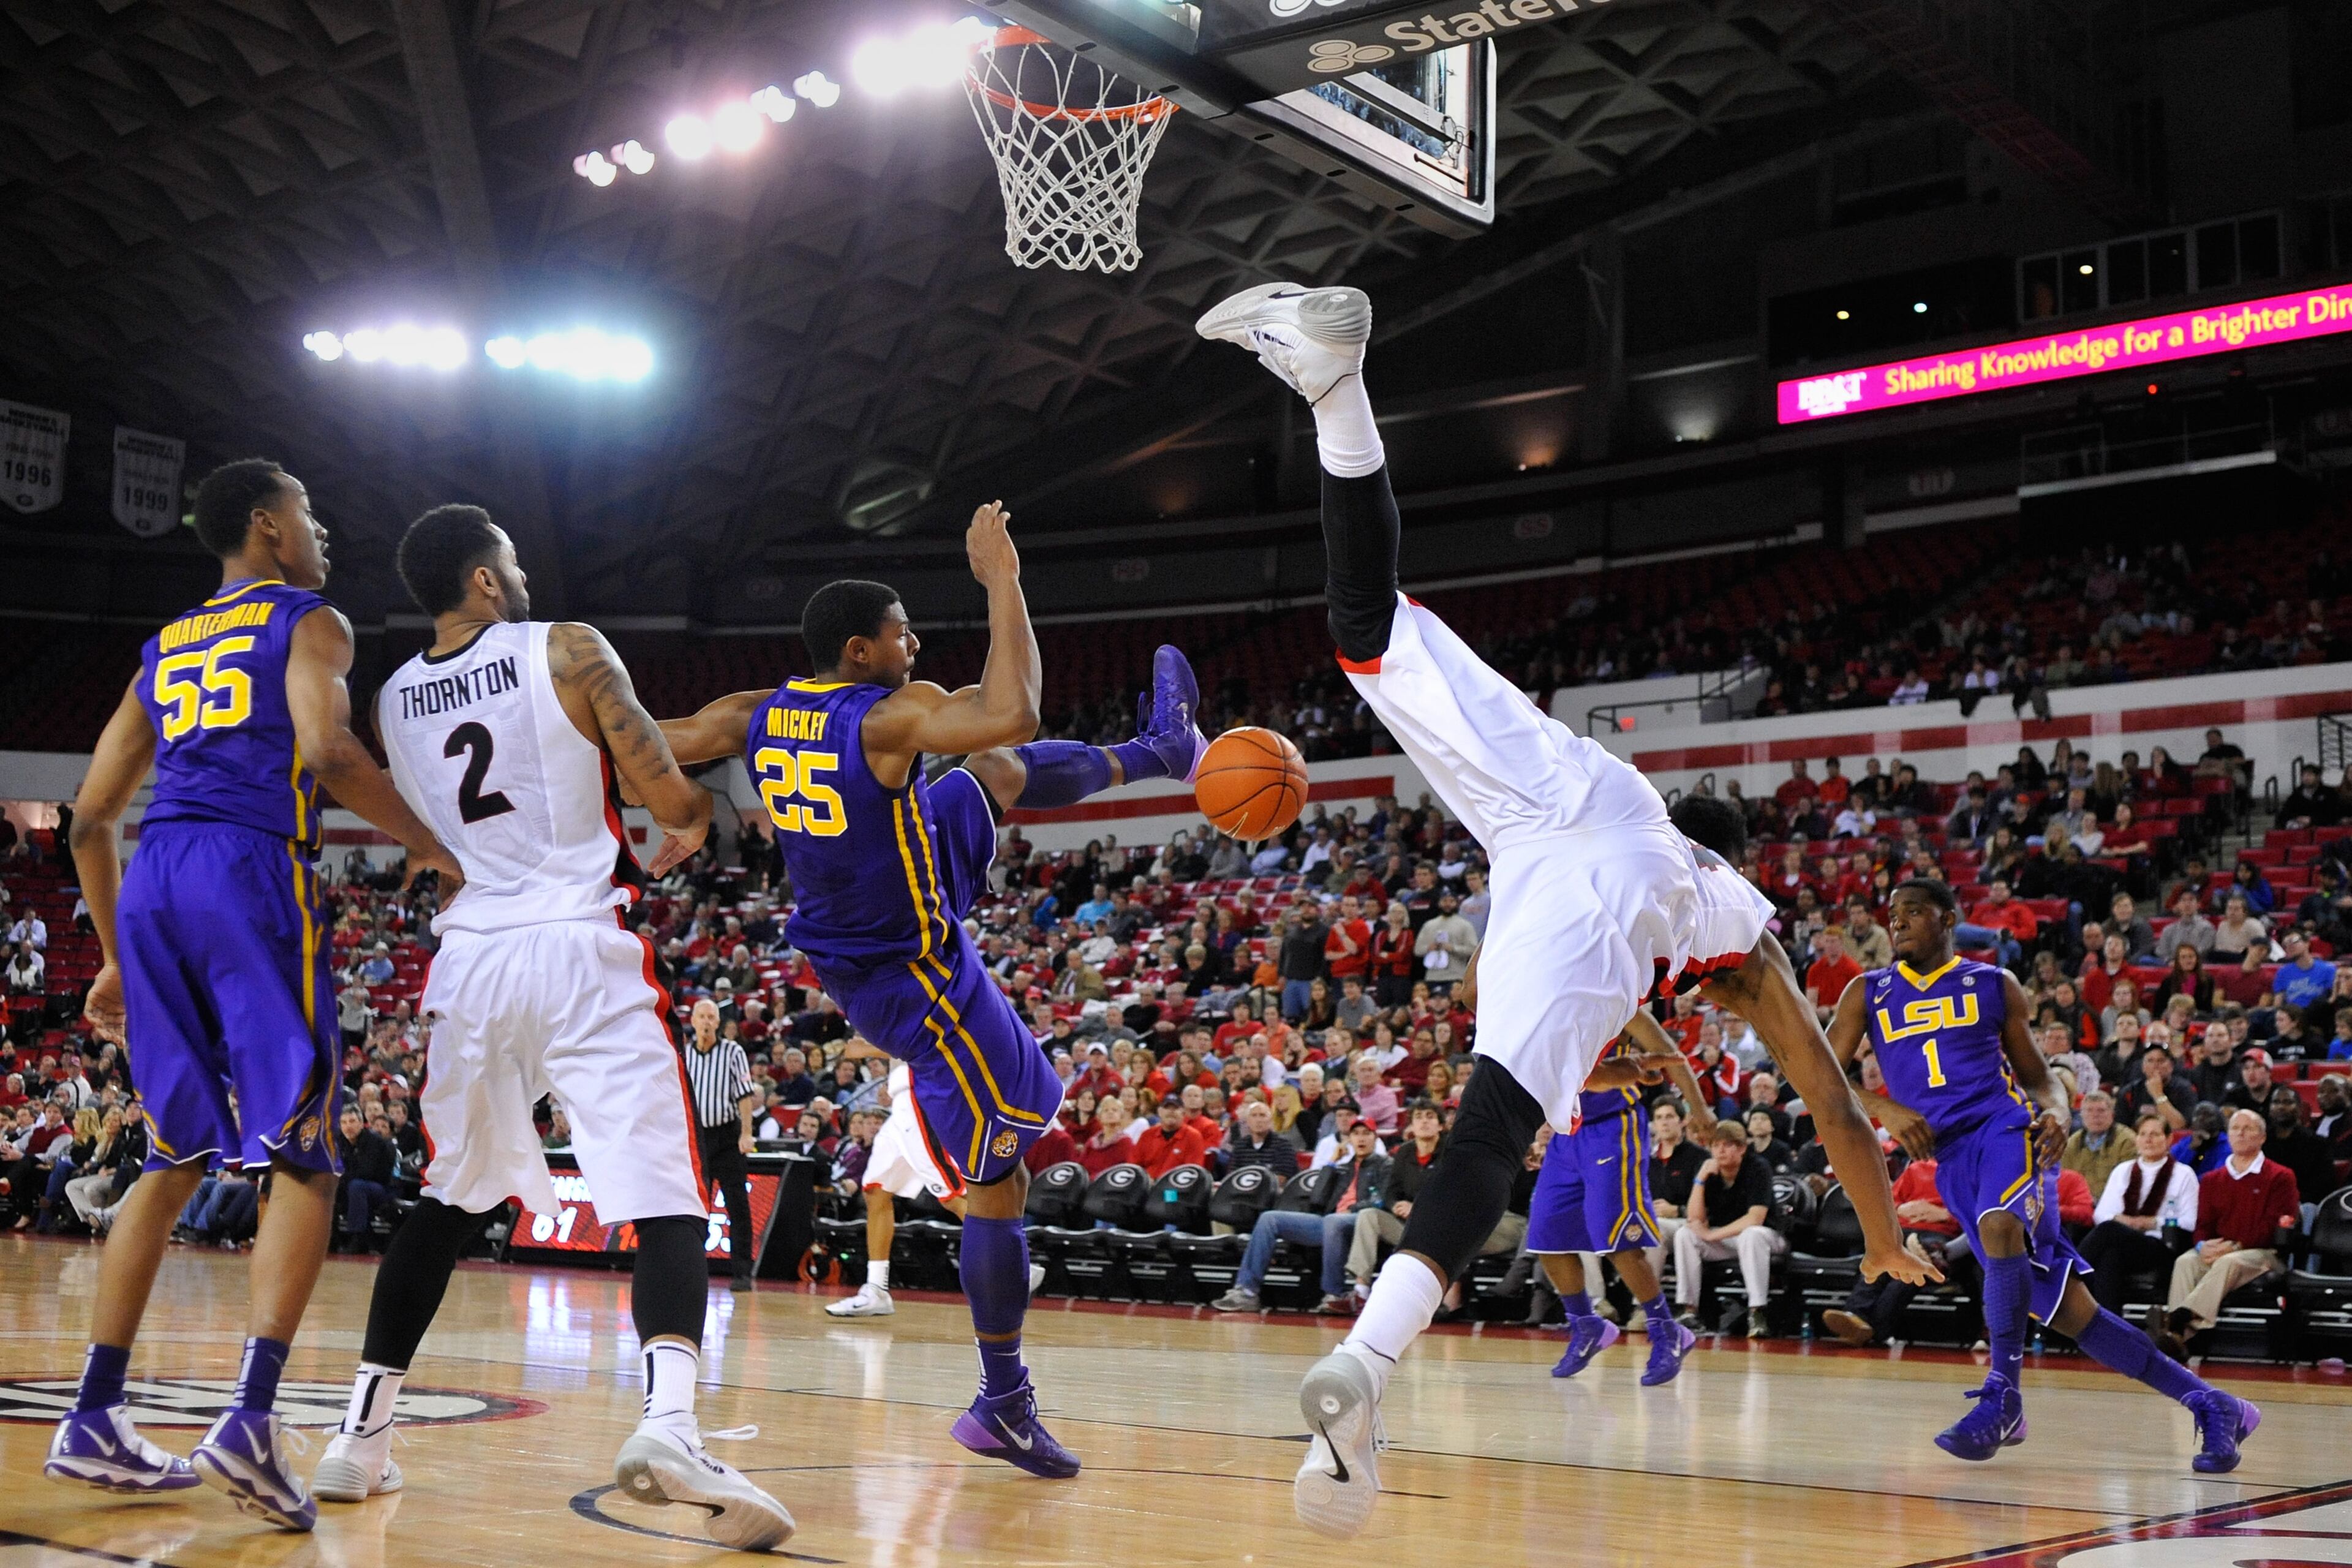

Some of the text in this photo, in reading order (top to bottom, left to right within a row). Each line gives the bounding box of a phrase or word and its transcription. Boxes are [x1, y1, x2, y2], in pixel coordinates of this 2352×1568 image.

[1885, 360, 1977, 394] Sharing
[1981, 334, 2119, 379] Knowledge
[2124, 326, 2163, 355] for
[2167, 326, 2185, 347] a
[2191, 306, 2302, 345] Brighter
[5, 460, 51, 488] 1996
[124, 486, 168, 513] 1999
[159, 602, 275, 654] QUARTERMAN
[154, 635, 255, 743] 55
[399, 656, 519, 720] THORNTON
[767, 707, 829, 741] MICKEY
[443, 722, 516, 824] 2
[755, 747, 848, 837] 25
[1876, 992, 1980, 1044] LSU
[1922, 1038, 1947, 1088] 1
